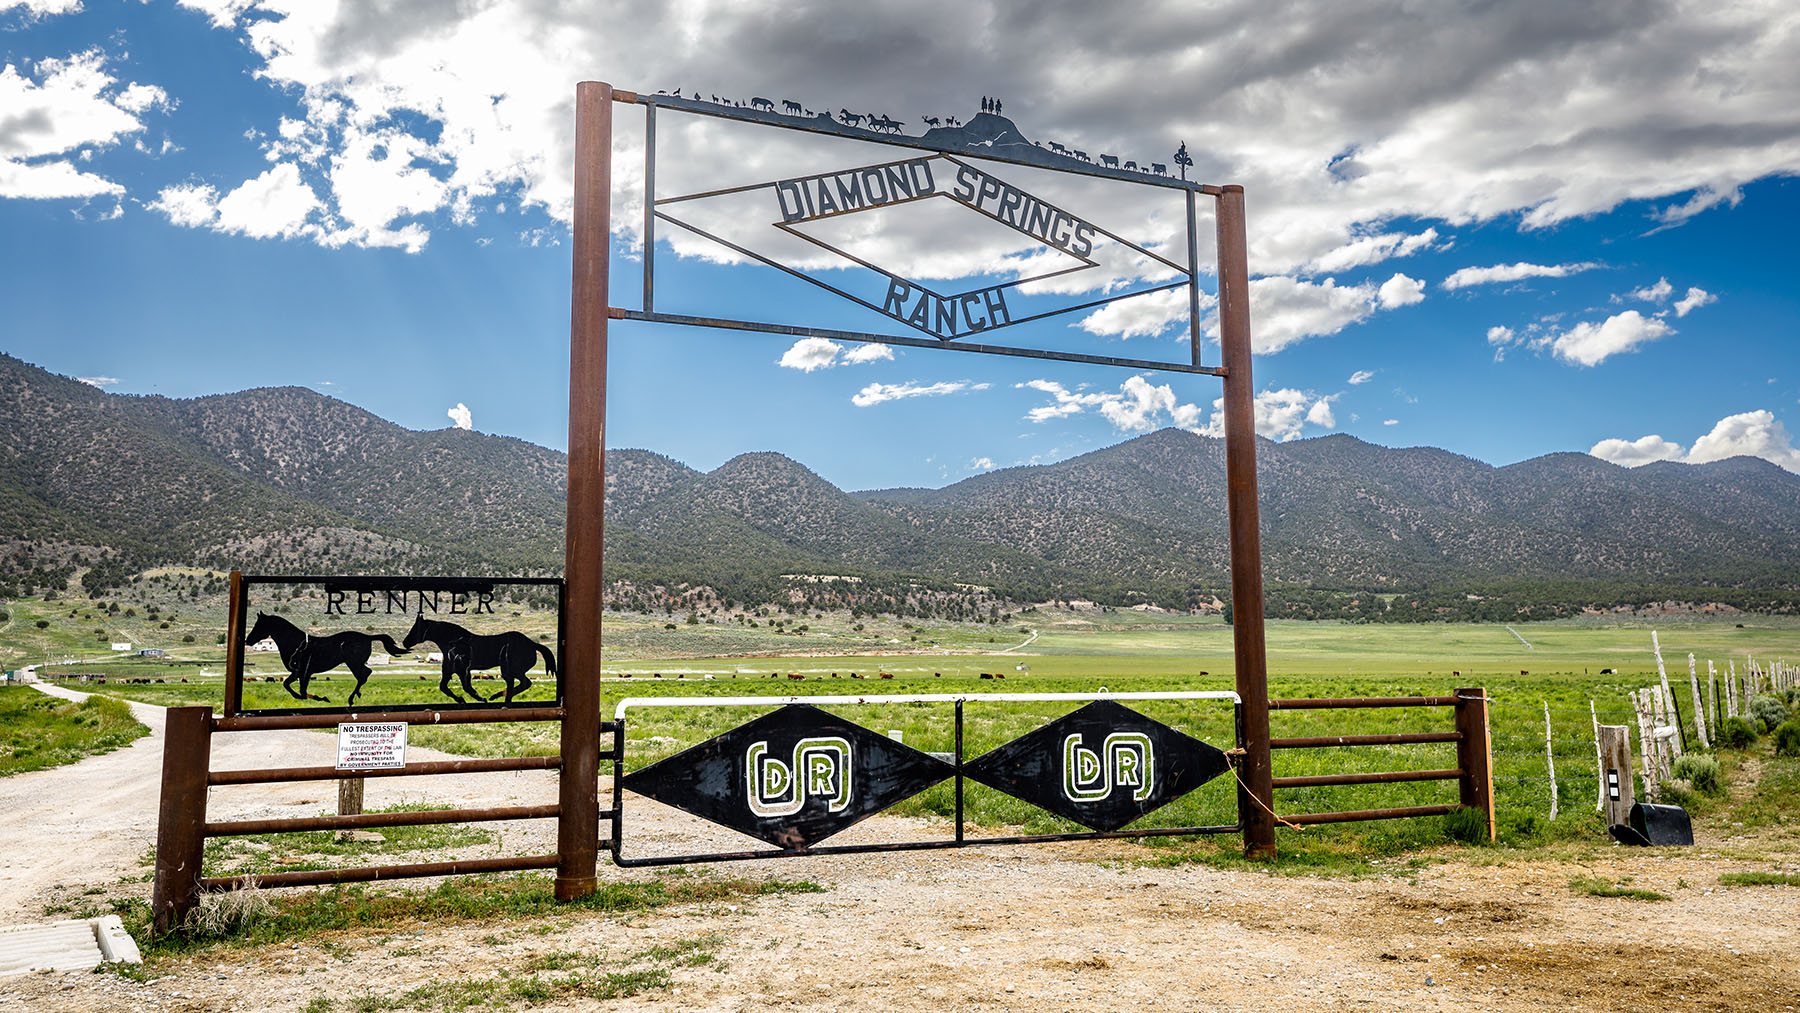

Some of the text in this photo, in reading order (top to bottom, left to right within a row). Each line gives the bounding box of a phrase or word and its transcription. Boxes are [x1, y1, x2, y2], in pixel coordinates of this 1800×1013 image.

[777, 160, 1096, 257] DIAMOND SPRINGS
[884, 277, 1010, 335] RANCH
[324, 590, 495, 615] RENNER
